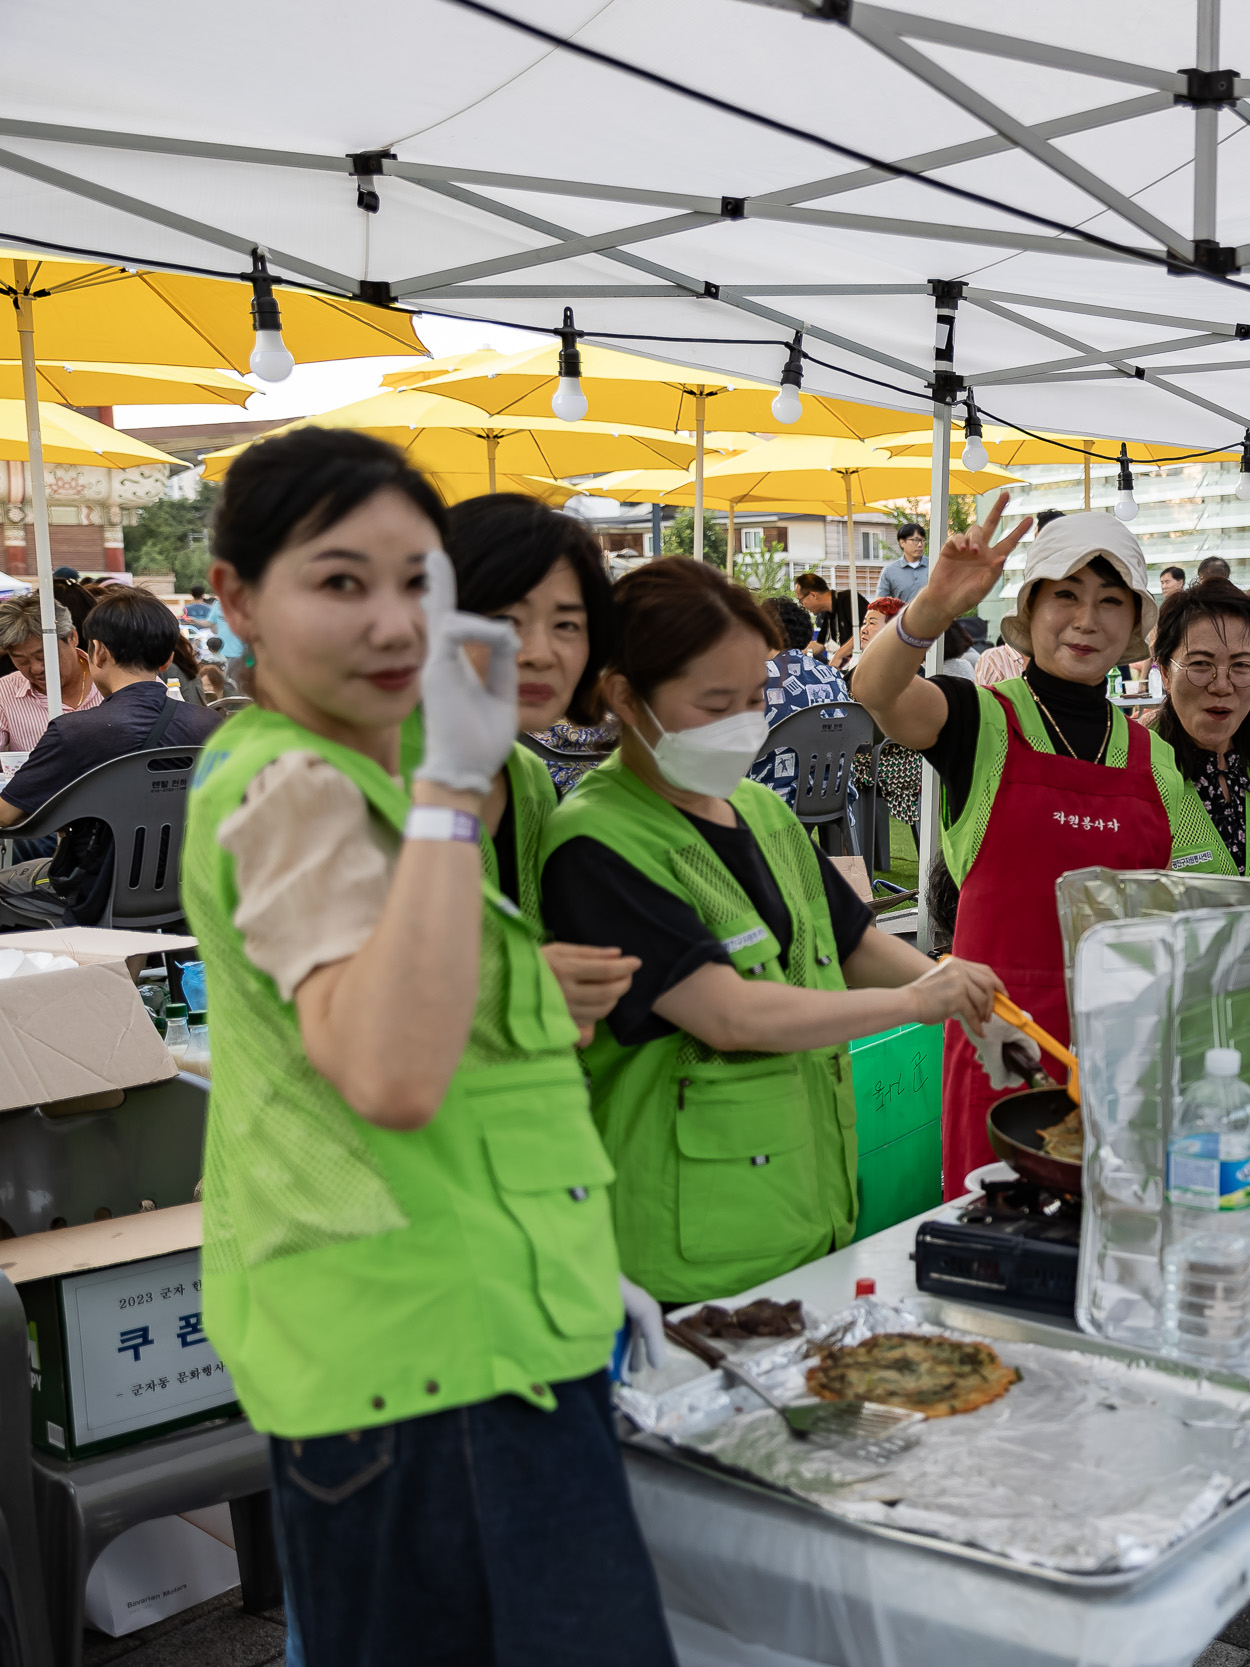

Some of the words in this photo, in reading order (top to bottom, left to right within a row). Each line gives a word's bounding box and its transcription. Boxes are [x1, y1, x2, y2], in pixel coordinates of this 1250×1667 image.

[1053, 811, 1120, 832] 자원봉사자
[119, 1292, 153, 1309] 2023
[160, 1283, 185, 1299] 군자
[132, 1377, 169, 1396] 군자동
[177, 1361, 225, 1383] 문화행사
[127, 1594, 160, 1608] Bavarian
[162, 1583, 188, 1597] Motors
